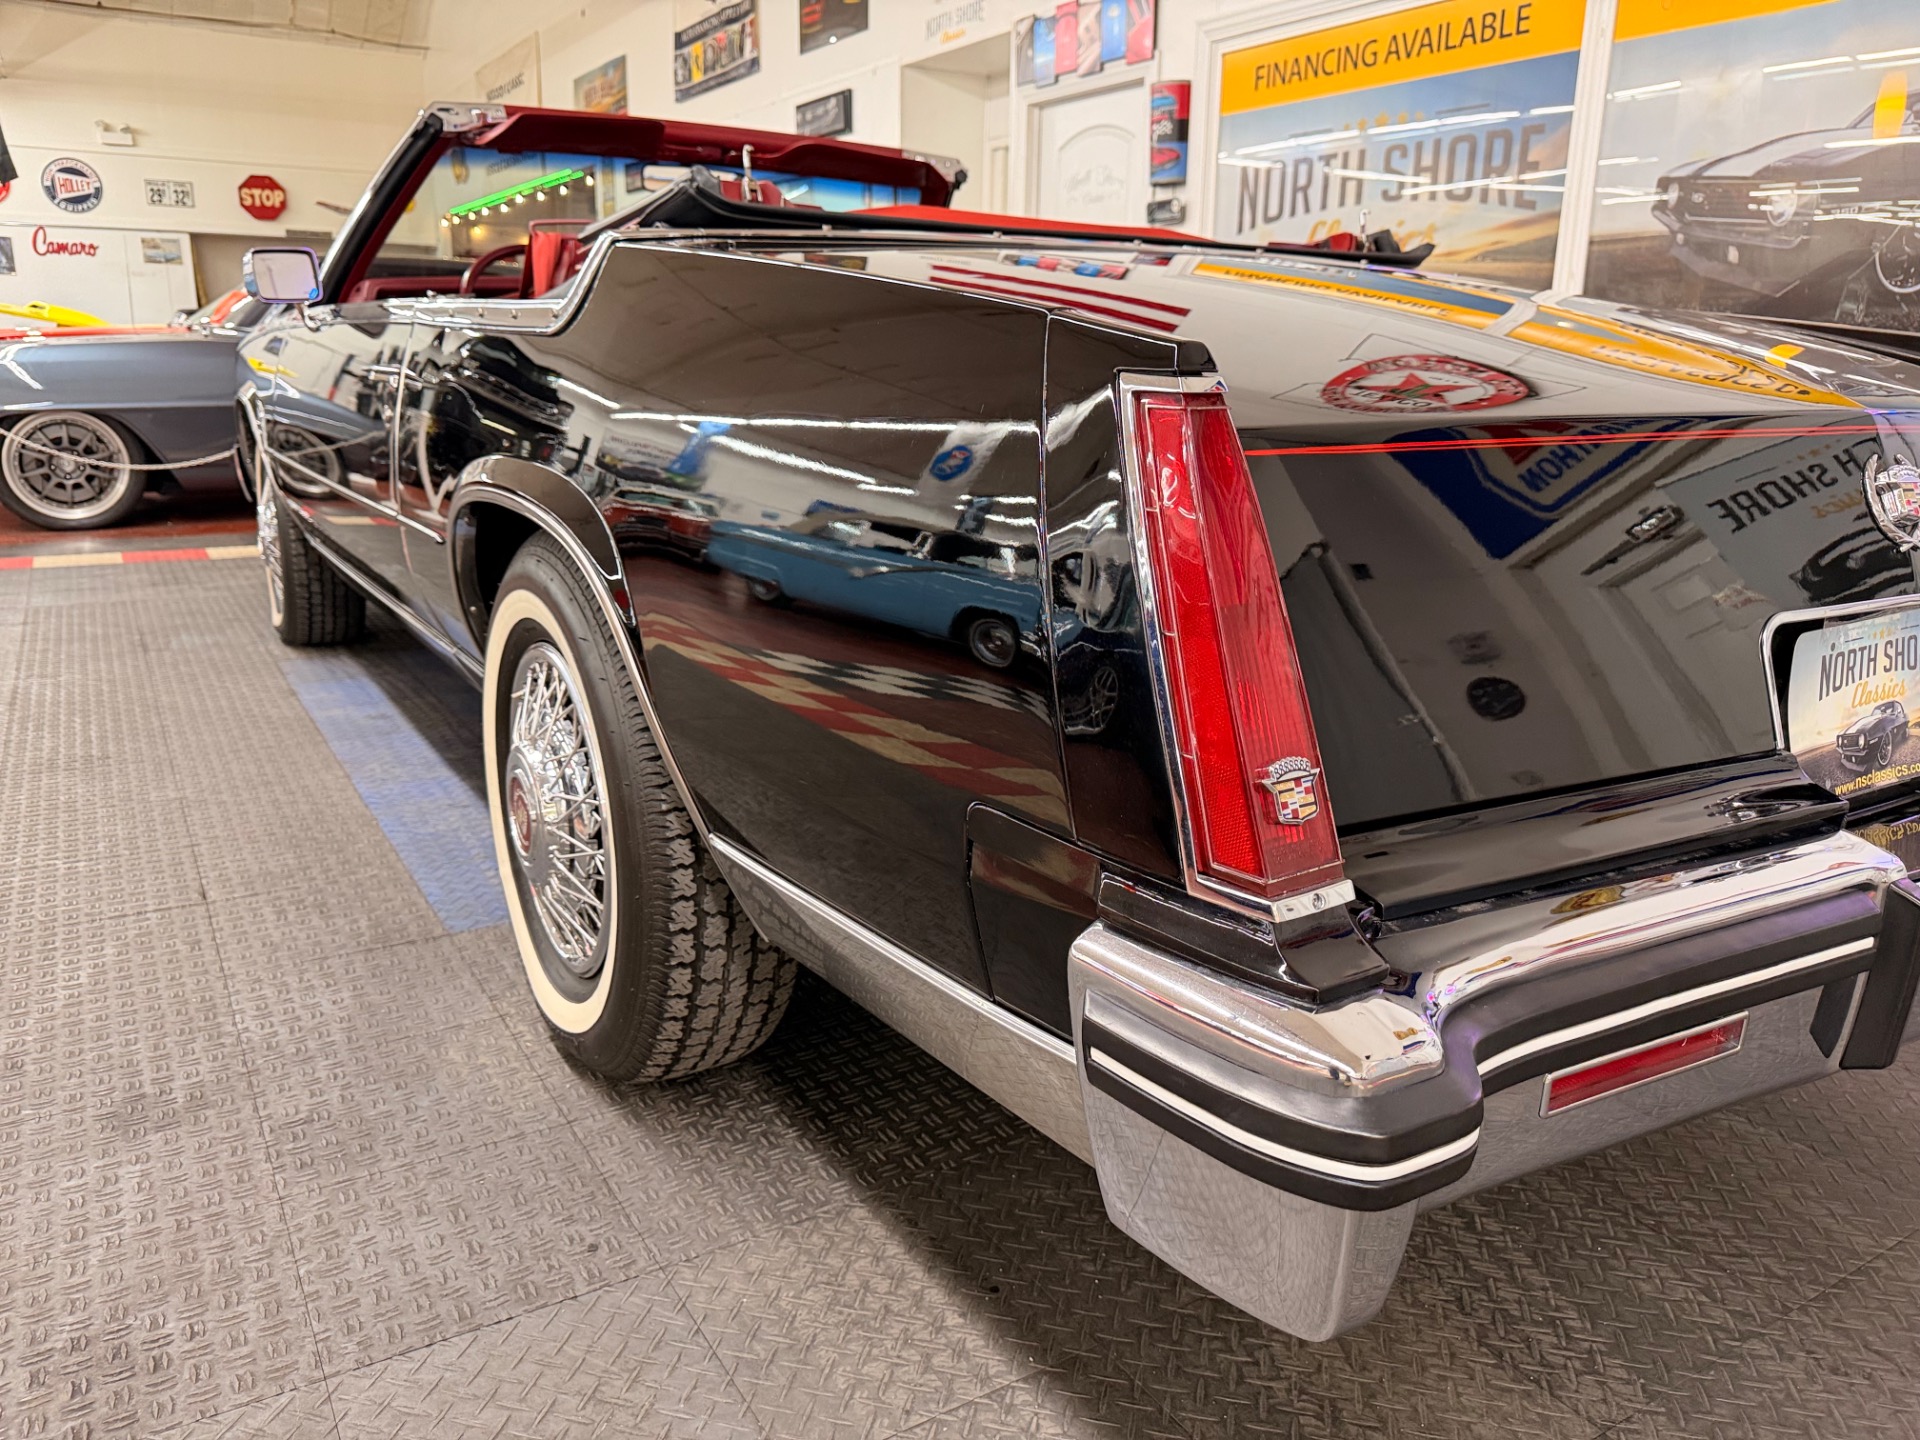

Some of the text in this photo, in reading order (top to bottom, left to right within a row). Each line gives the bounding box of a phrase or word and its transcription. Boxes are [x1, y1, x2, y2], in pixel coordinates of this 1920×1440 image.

[1254, 3, 1532, 91] FINANCING AVAILABLE
[58, 176, 91, 194] HOLLEY
[1236, 123, 1547, 236] NORTH SHORE
[240, 187, 285, 208] STOP
[32, 226, 99, 257] Camaro
[1819, 634, 1920, 702] NORTH SHO
[1851, 678, 1907, 708] Classics
